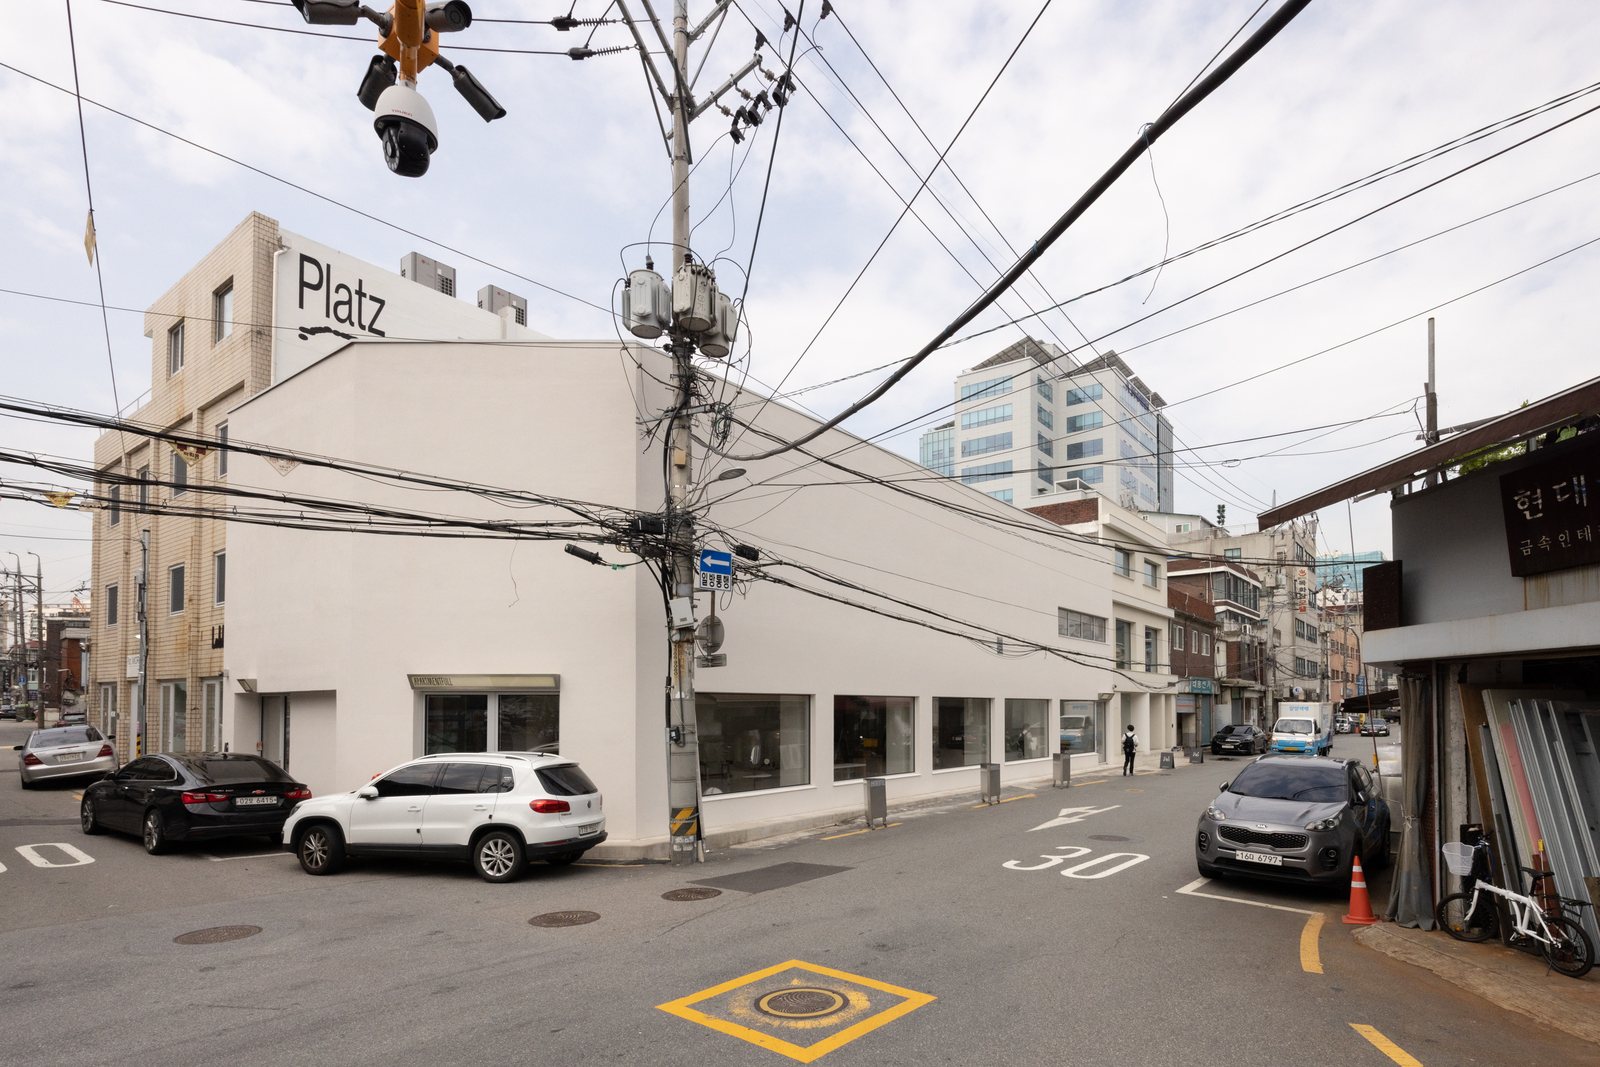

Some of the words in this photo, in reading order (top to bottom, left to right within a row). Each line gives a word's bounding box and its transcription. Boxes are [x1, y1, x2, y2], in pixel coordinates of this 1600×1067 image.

[299, 253, 385, 337] Platz
[1513, 475, 1600, 520] 현대
[701, 572, 730, 589] 일방통행
[1002, 846, 1150, 879] 30
[1258, 855, 1278, 864] 6797
